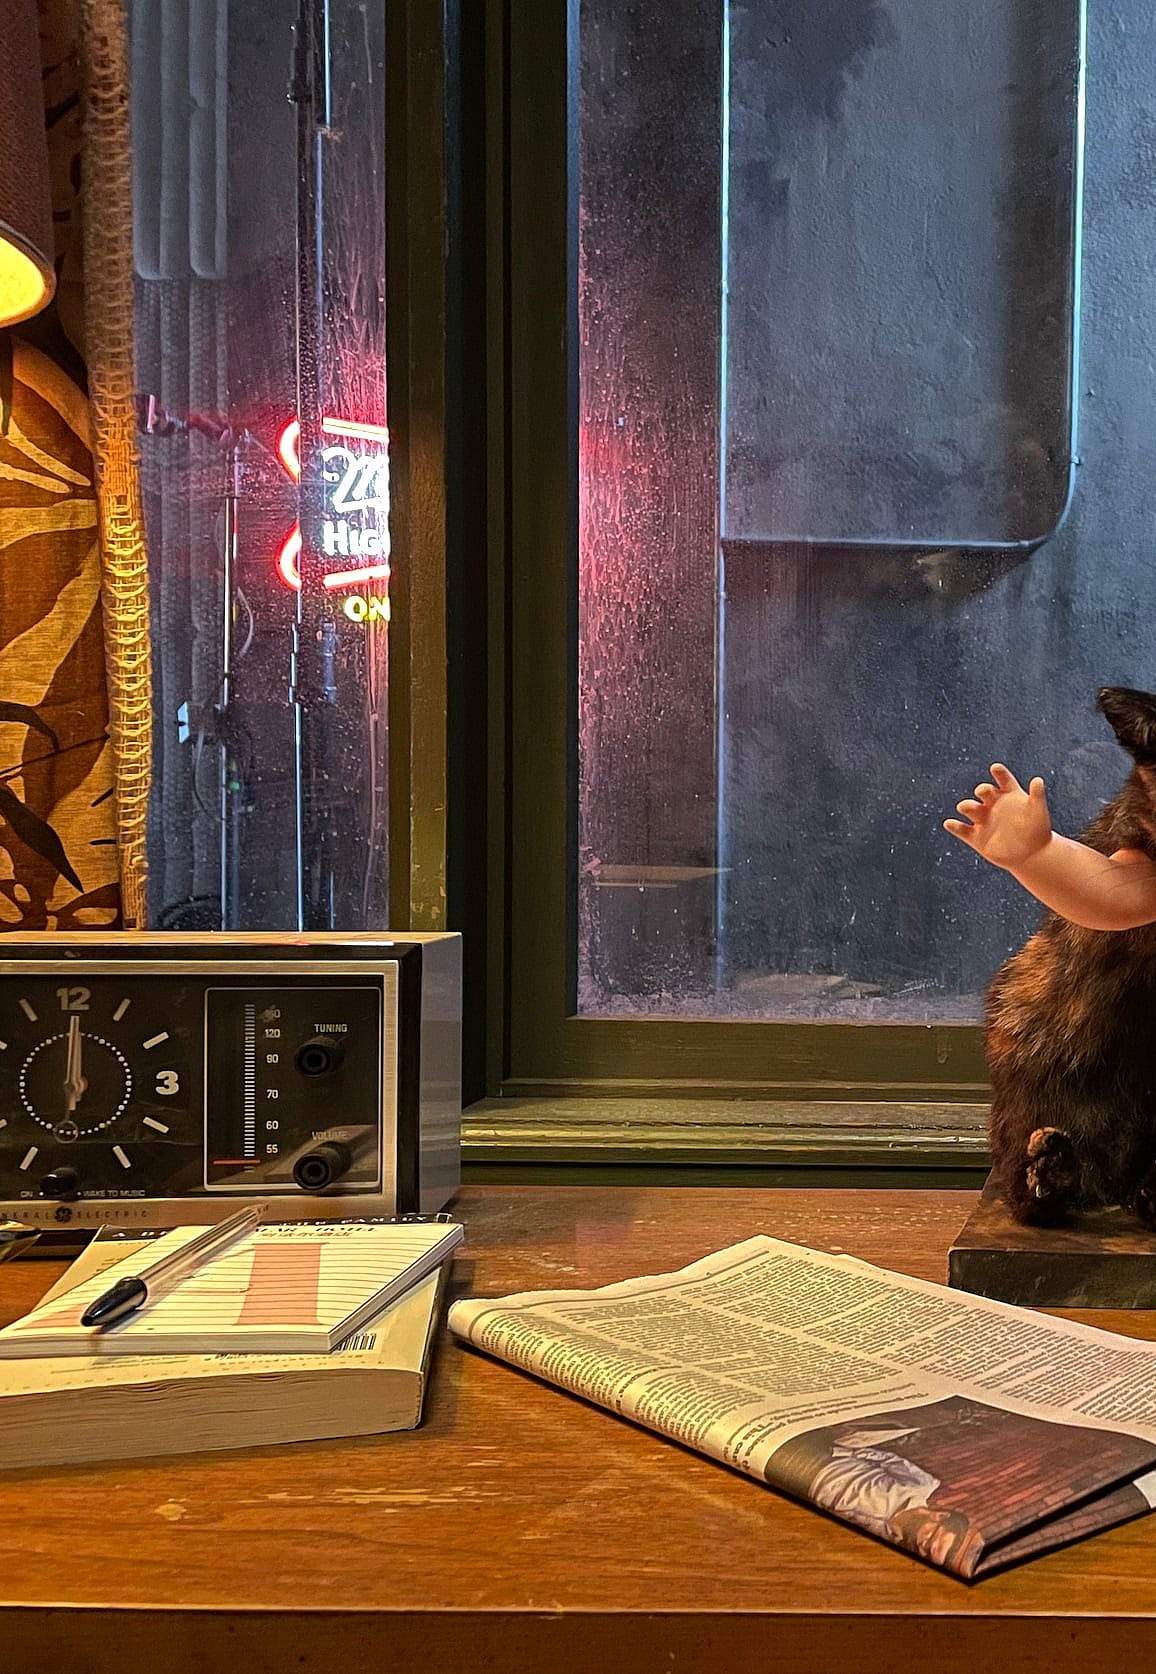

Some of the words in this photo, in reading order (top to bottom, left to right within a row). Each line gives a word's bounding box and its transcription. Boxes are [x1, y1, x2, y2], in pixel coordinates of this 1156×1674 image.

[344, 595, 391, 622] ON
[56, 986, 91, 1011] 12
[313, 1023, 348, 1033] TUNING
[264, 1028, 281, 1039] 120
[266, 1054, 279, 1064] 90
[155, 1070, 180, 1095] 3
[266, 1088, 279, 1099] 70
[265, 1120, 279, 1130] 60
[312, 1130, 349, 1141] VOLUME
[266, 1144, 278, 1154] 55
[83, 1190, 106, 1198] WAKE
[108, 1189, 119, 1197] TO
[120, 1189, 146, 1197] MUSIC
[77, 1209, 148, 1219] ELECTRIC
